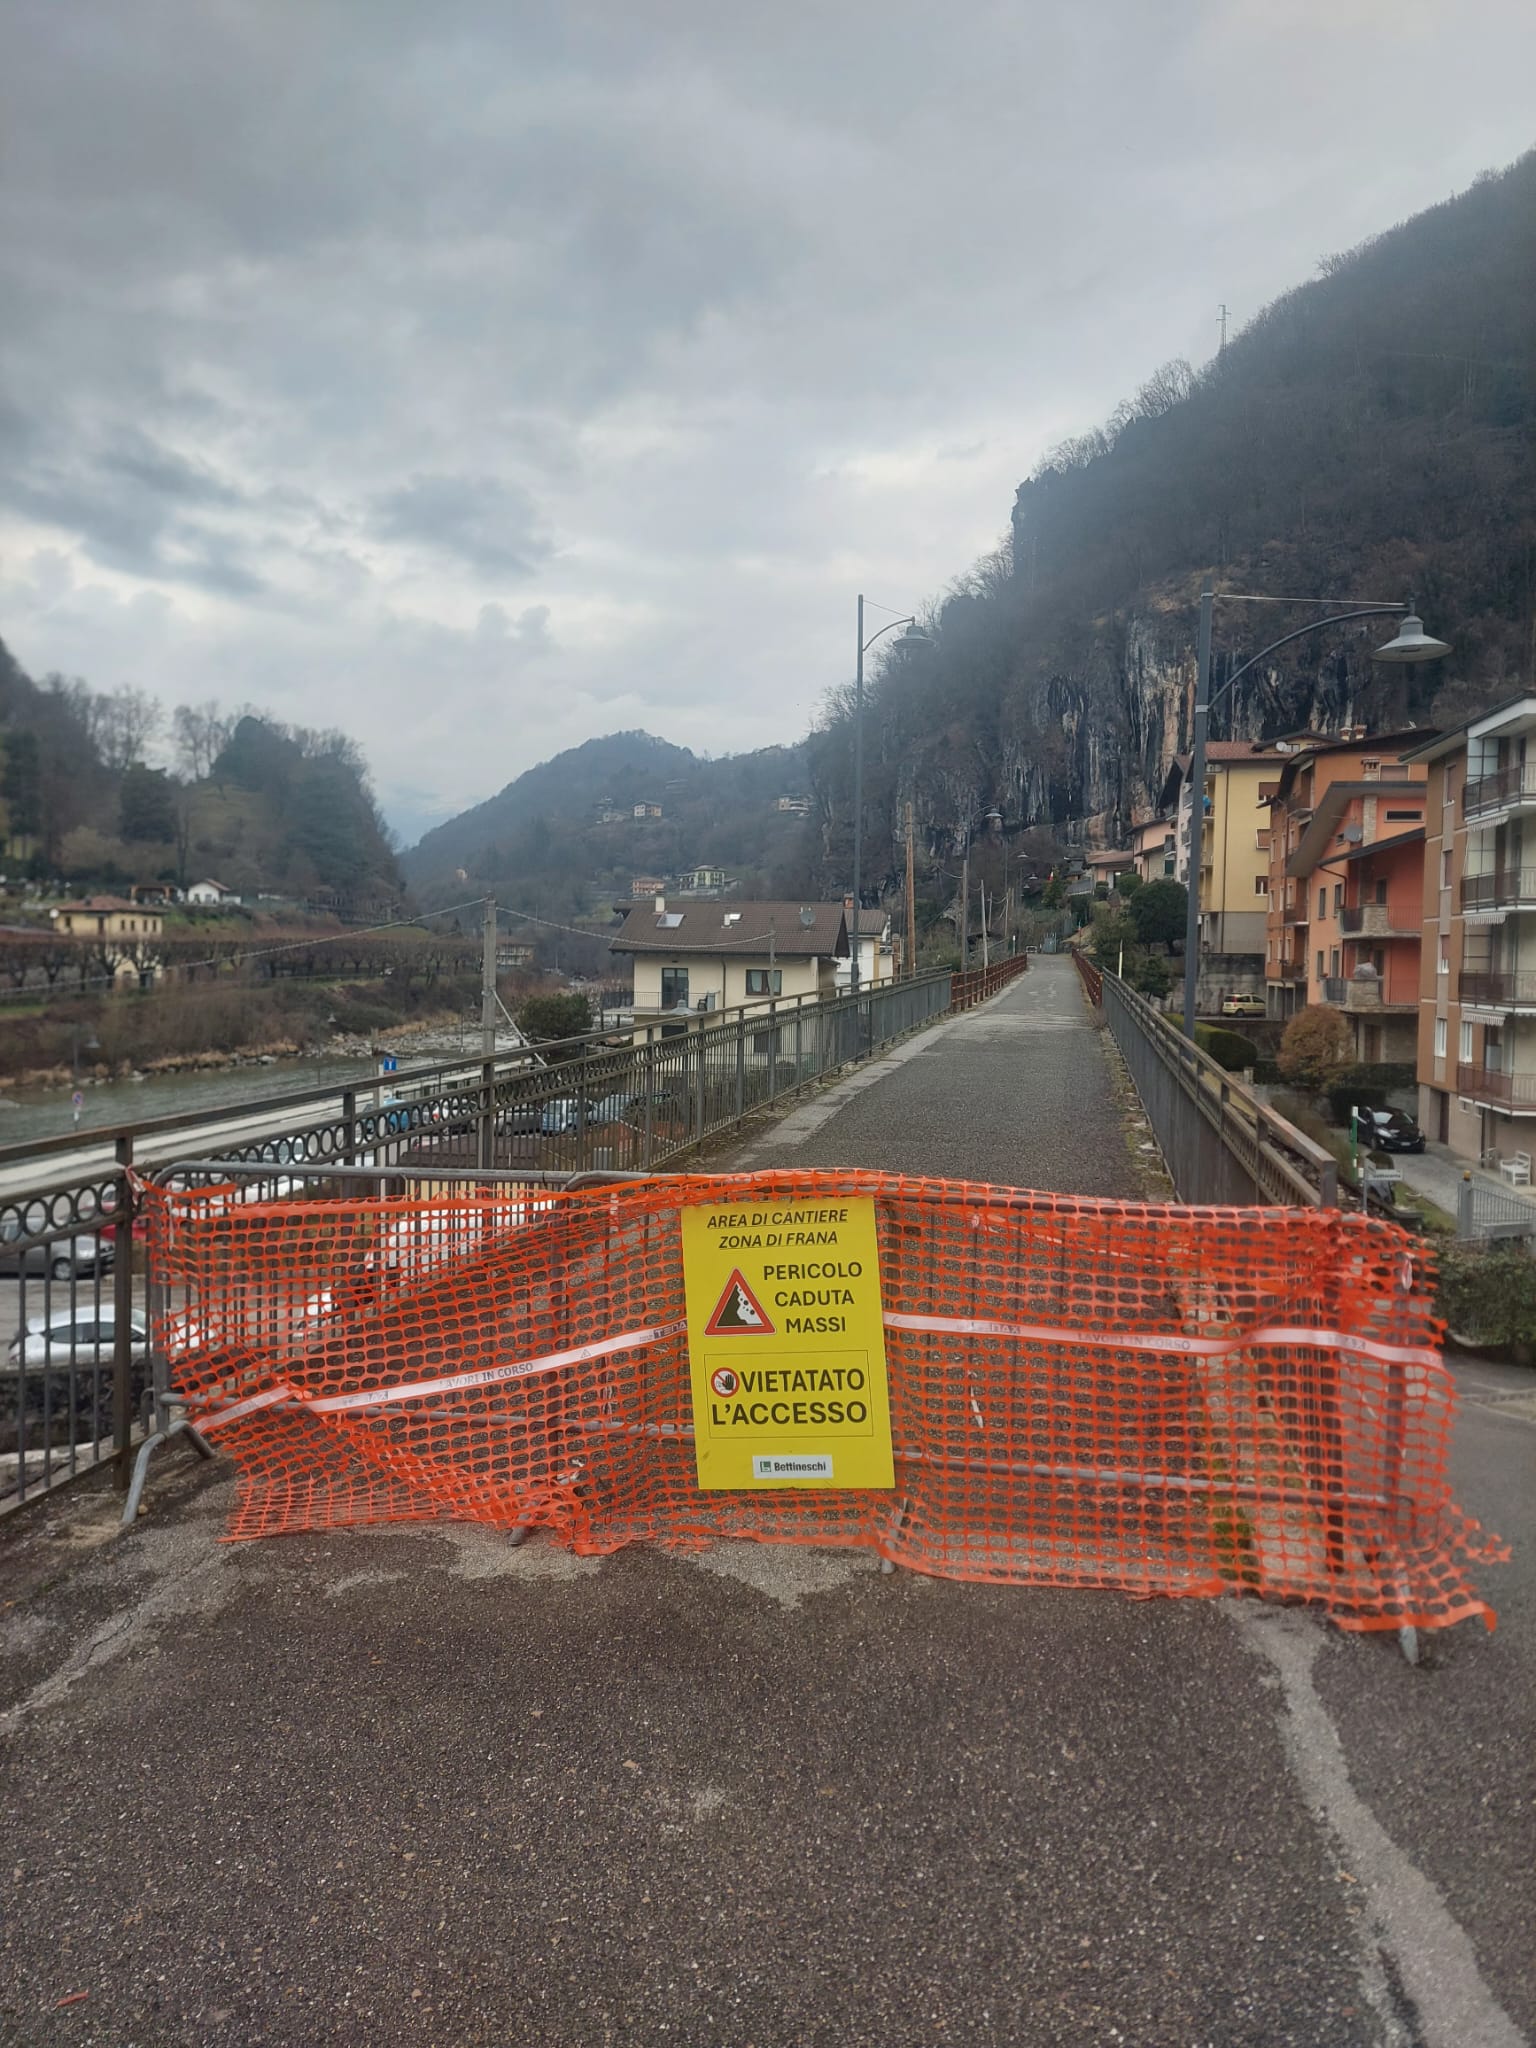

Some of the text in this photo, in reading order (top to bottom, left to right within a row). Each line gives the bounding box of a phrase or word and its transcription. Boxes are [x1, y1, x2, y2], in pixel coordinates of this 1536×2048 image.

[707, 1208, 849, 1229] AREA DI CANTIERE
[718, 1230, 838, 1249] ZONA DI FRANA
[763, 1261, 863, 1281] PERICOLO
[774, 1289, 855, 1307] CADUTA
[785, 1316, 846, 1334] MASSI
[482, 1370, 495, 1382] IN
[497, 1362, 534, 1378] CORSO
[740, 1368, 865, 1393] VIETATATO
[711, 1401, 868, 1426] L'ACCESSO
[773, 1461, 827, 1472] Bettineschi
